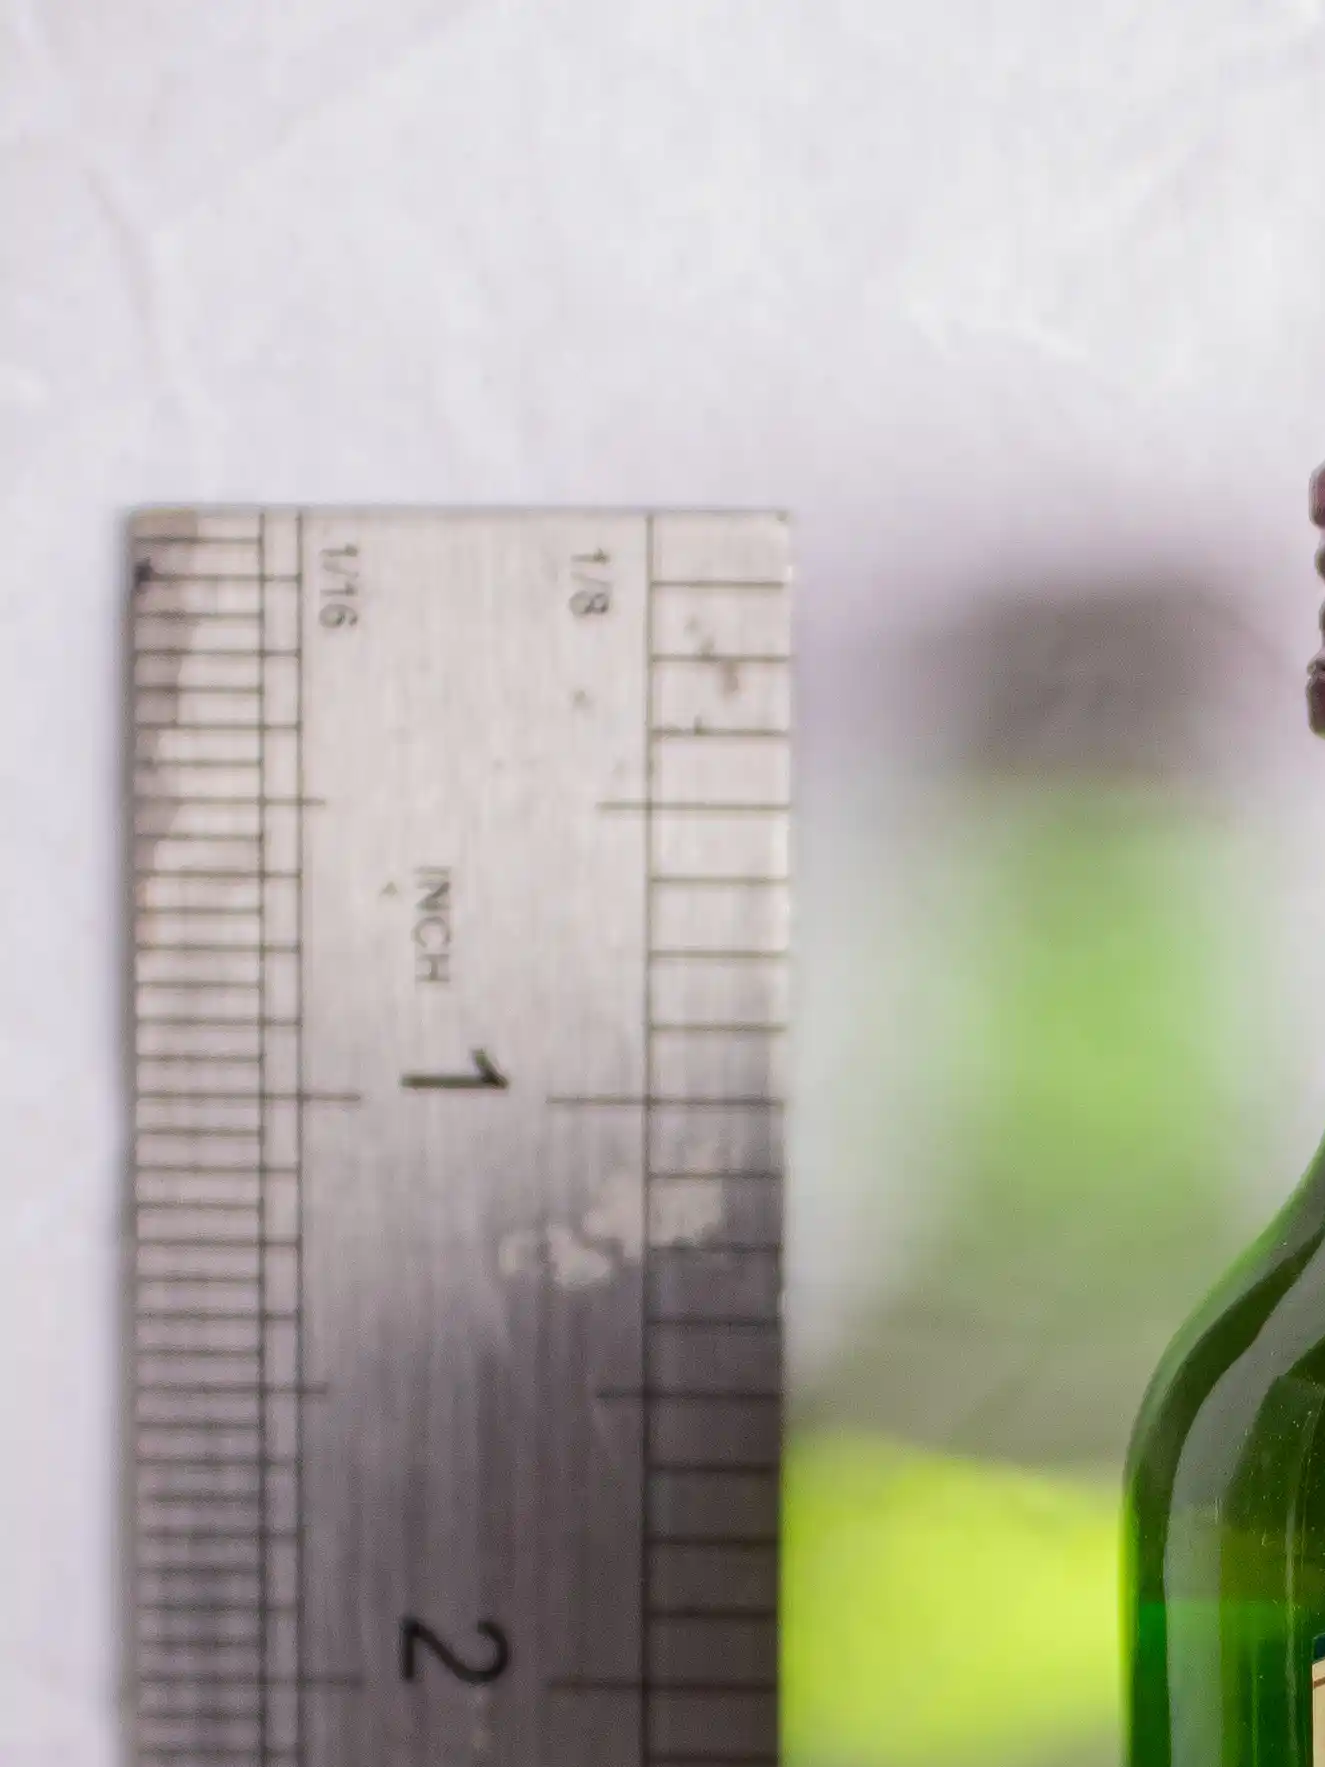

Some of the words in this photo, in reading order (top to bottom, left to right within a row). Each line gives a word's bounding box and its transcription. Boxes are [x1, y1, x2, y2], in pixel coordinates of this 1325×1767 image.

[319, 544, 359, 630] 1/16
[569, 549, 612, 618] 1/8
[410, 866, 453, 984] INCH
[400, 1047, 509, 1090] 1
[400, 1615, 510, 1684] 2
